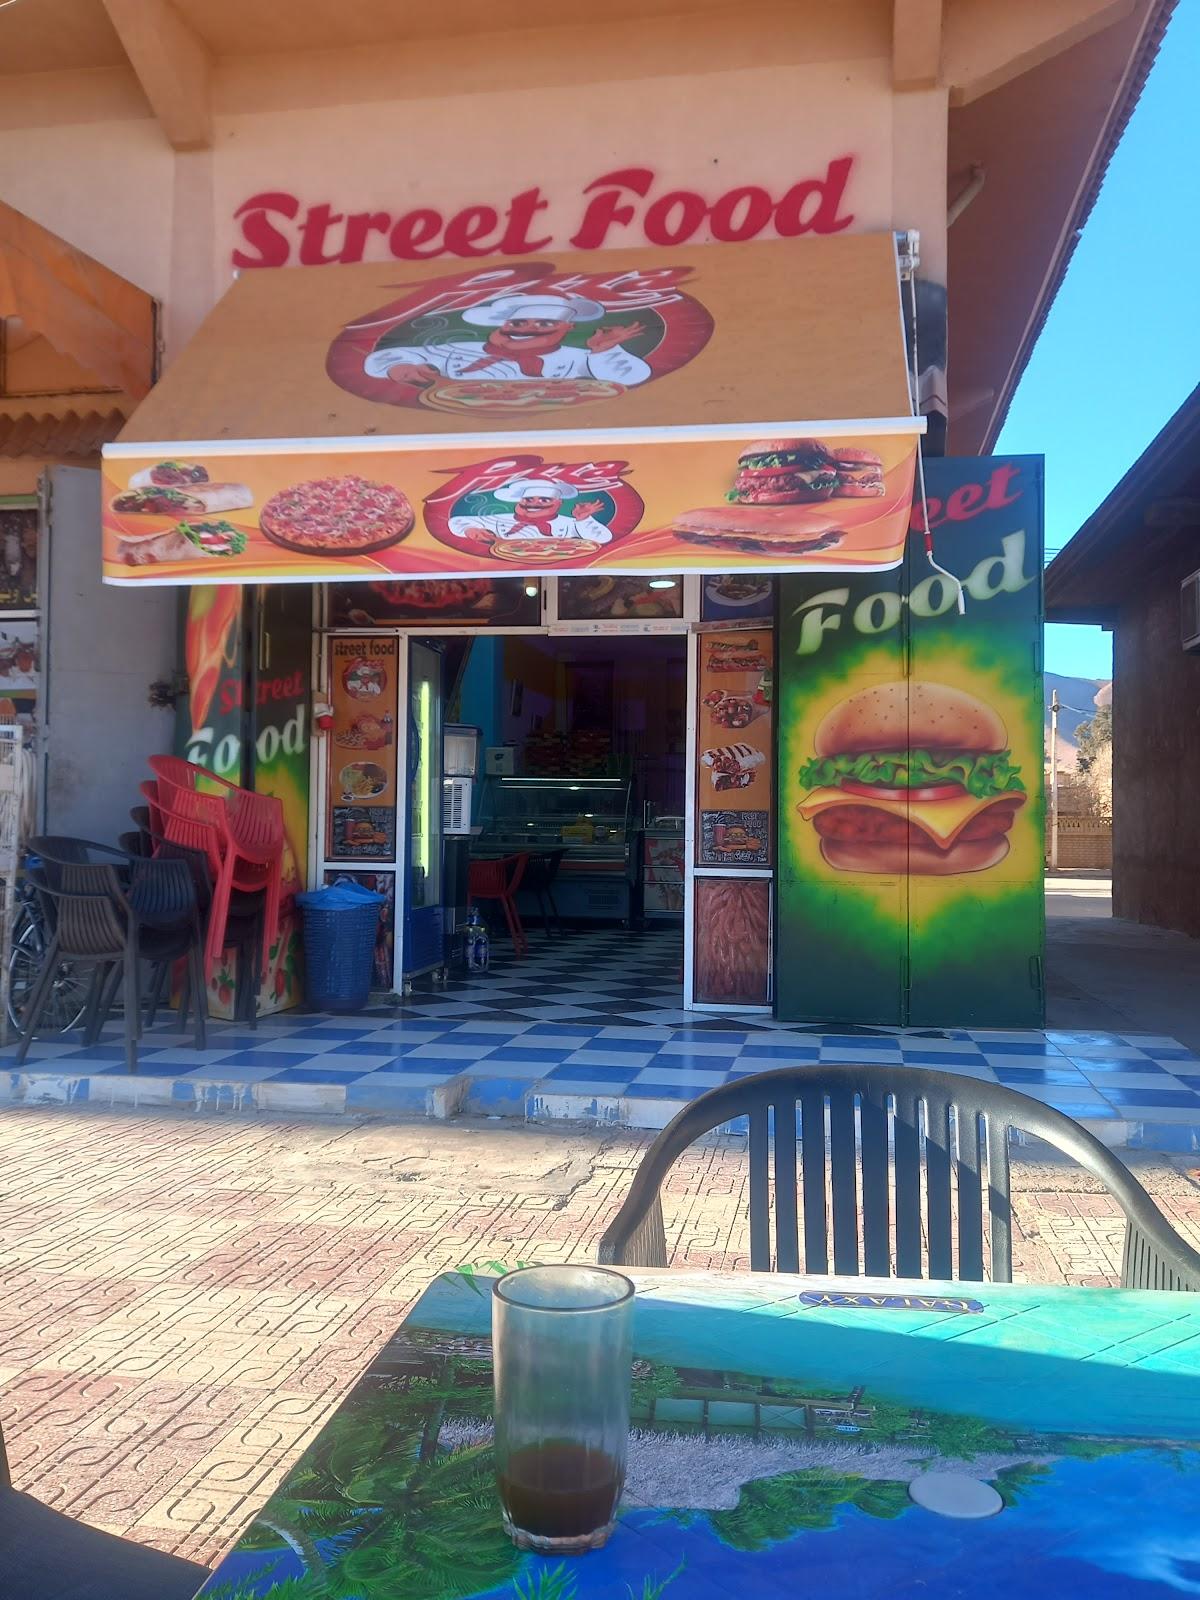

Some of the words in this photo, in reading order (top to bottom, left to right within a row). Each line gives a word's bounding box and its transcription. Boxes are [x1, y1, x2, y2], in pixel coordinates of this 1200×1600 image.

[232, 187, 552, 269] Street
[569, 156, 854, 250] Food
[909, 463, 1024, 532] eet
[790, 528, 1037, 655] Food
[368, 640, 395, 656] food
[819, 1293, 970, 1311] GALAXY
